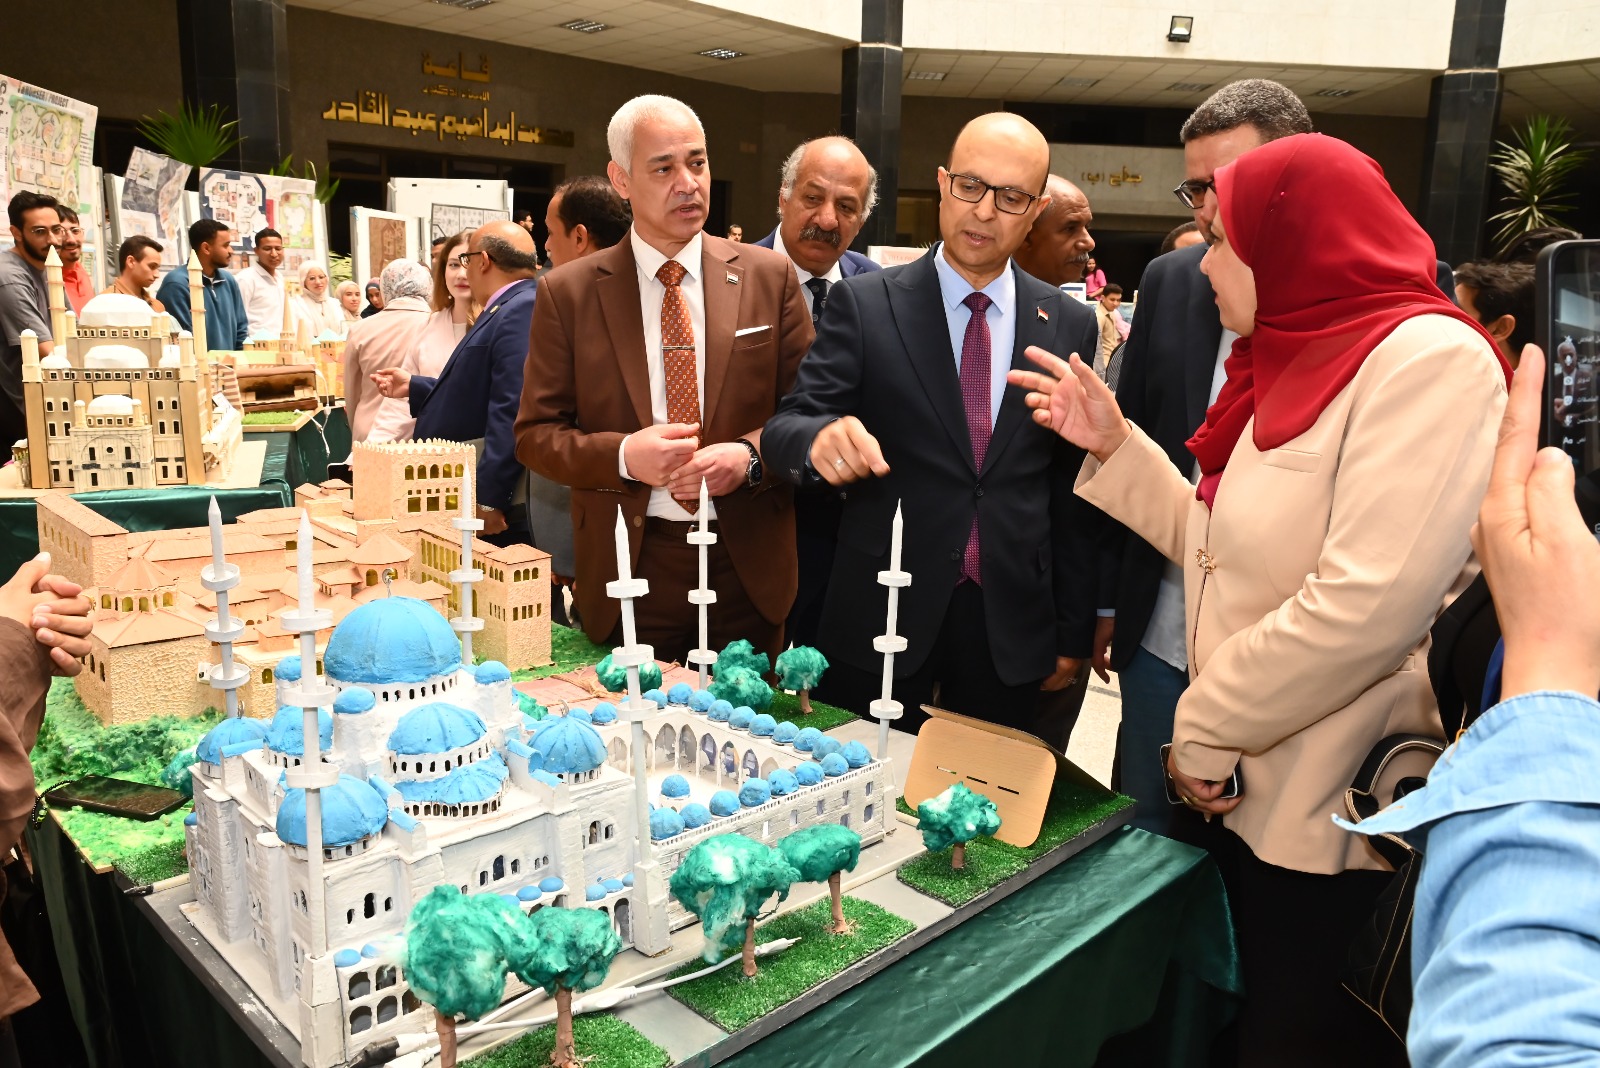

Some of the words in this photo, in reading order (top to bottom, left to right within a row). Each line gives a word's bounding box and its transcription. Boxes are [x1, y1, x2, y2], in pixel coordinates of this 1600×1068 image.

[422, 52, 491, 82] قاعة
[321, 90, 389, 127] القادر
[392, 107, 437, 136] عبد
[517, 124, 575, 147] محمد
